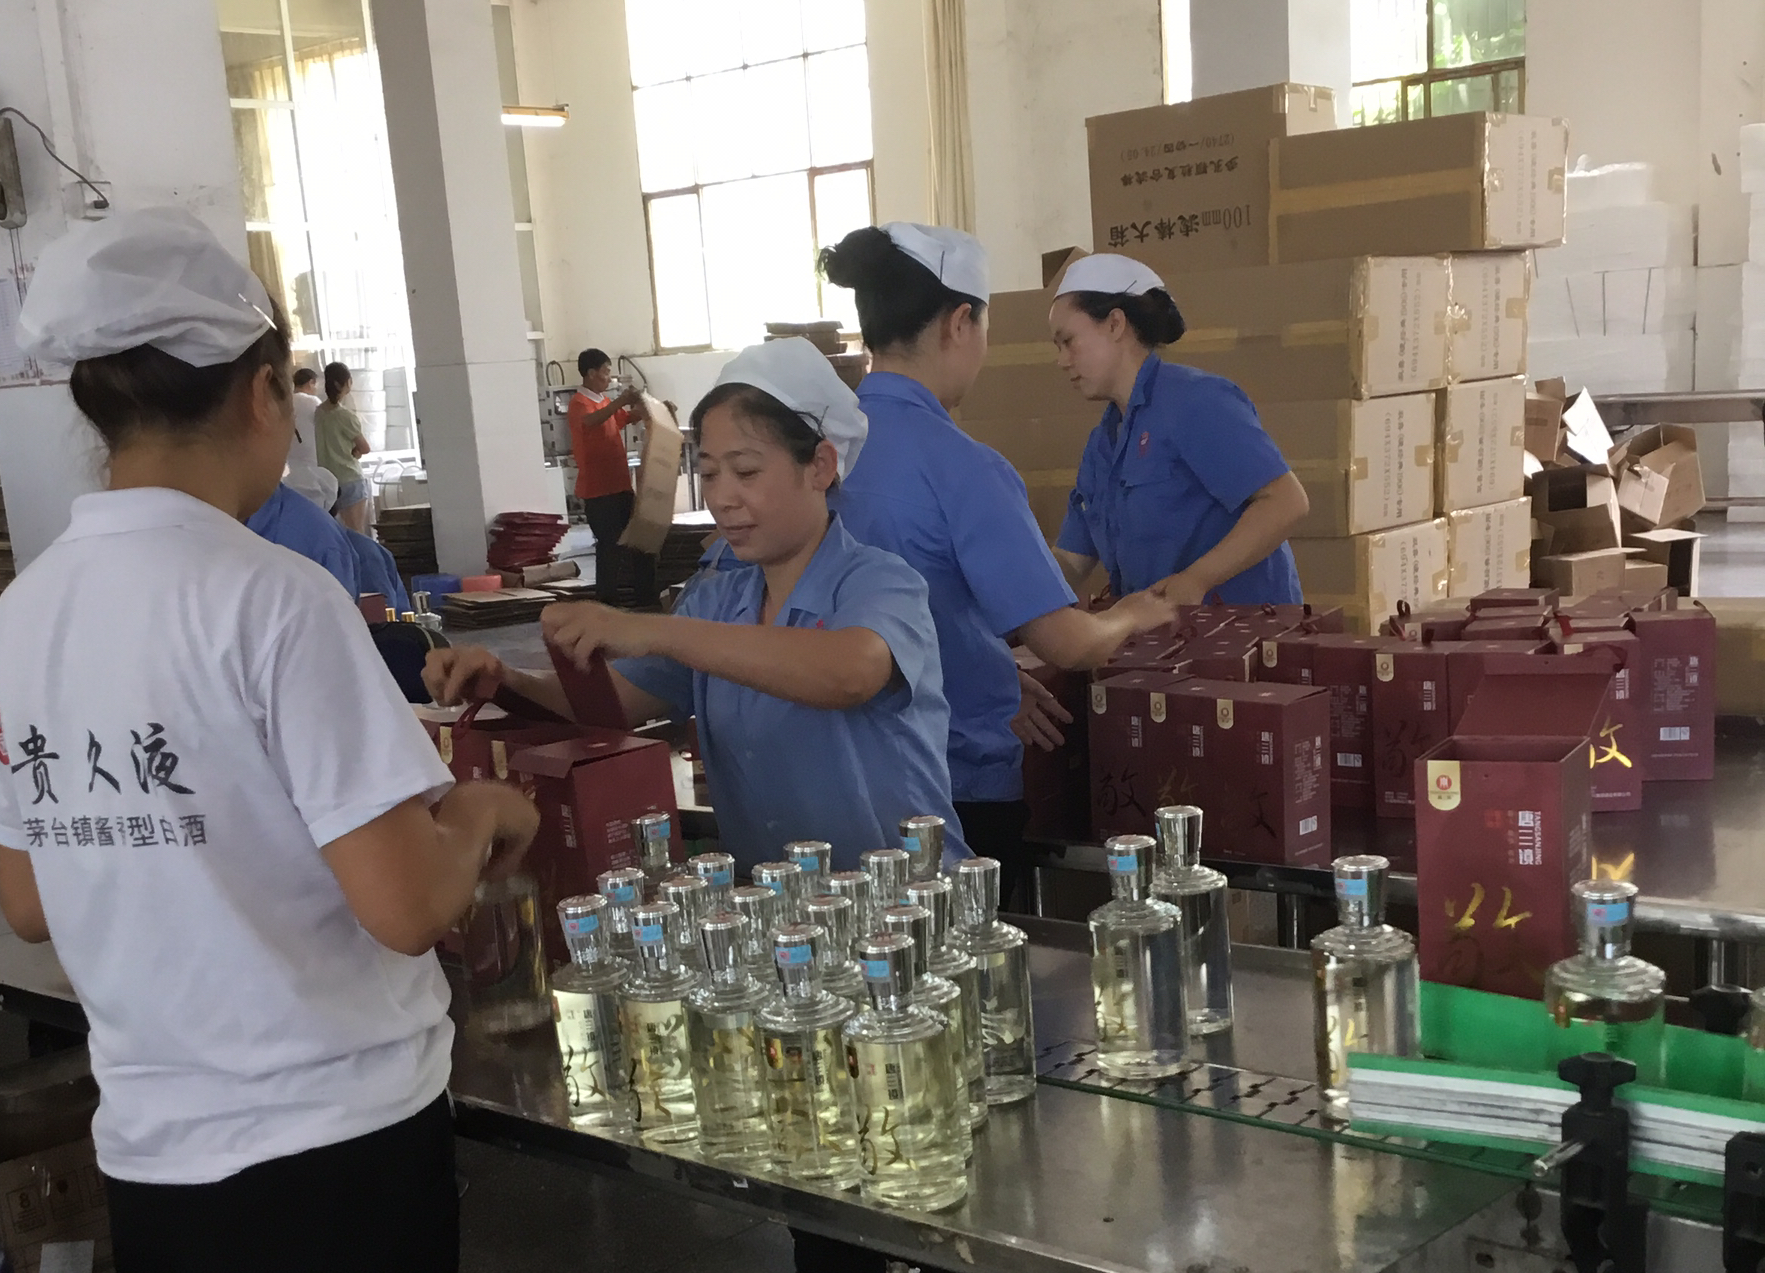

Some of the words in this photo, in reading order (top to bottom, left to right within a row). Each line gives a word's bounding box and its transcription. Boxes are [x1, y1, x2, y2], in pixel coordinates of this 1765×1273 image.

[1107, 204, 1252, 248] 100mm滤棒大箱
[11, 723, 196, 805] 贵久液
[1534, 811, 1542, 866] TANGSANJING
